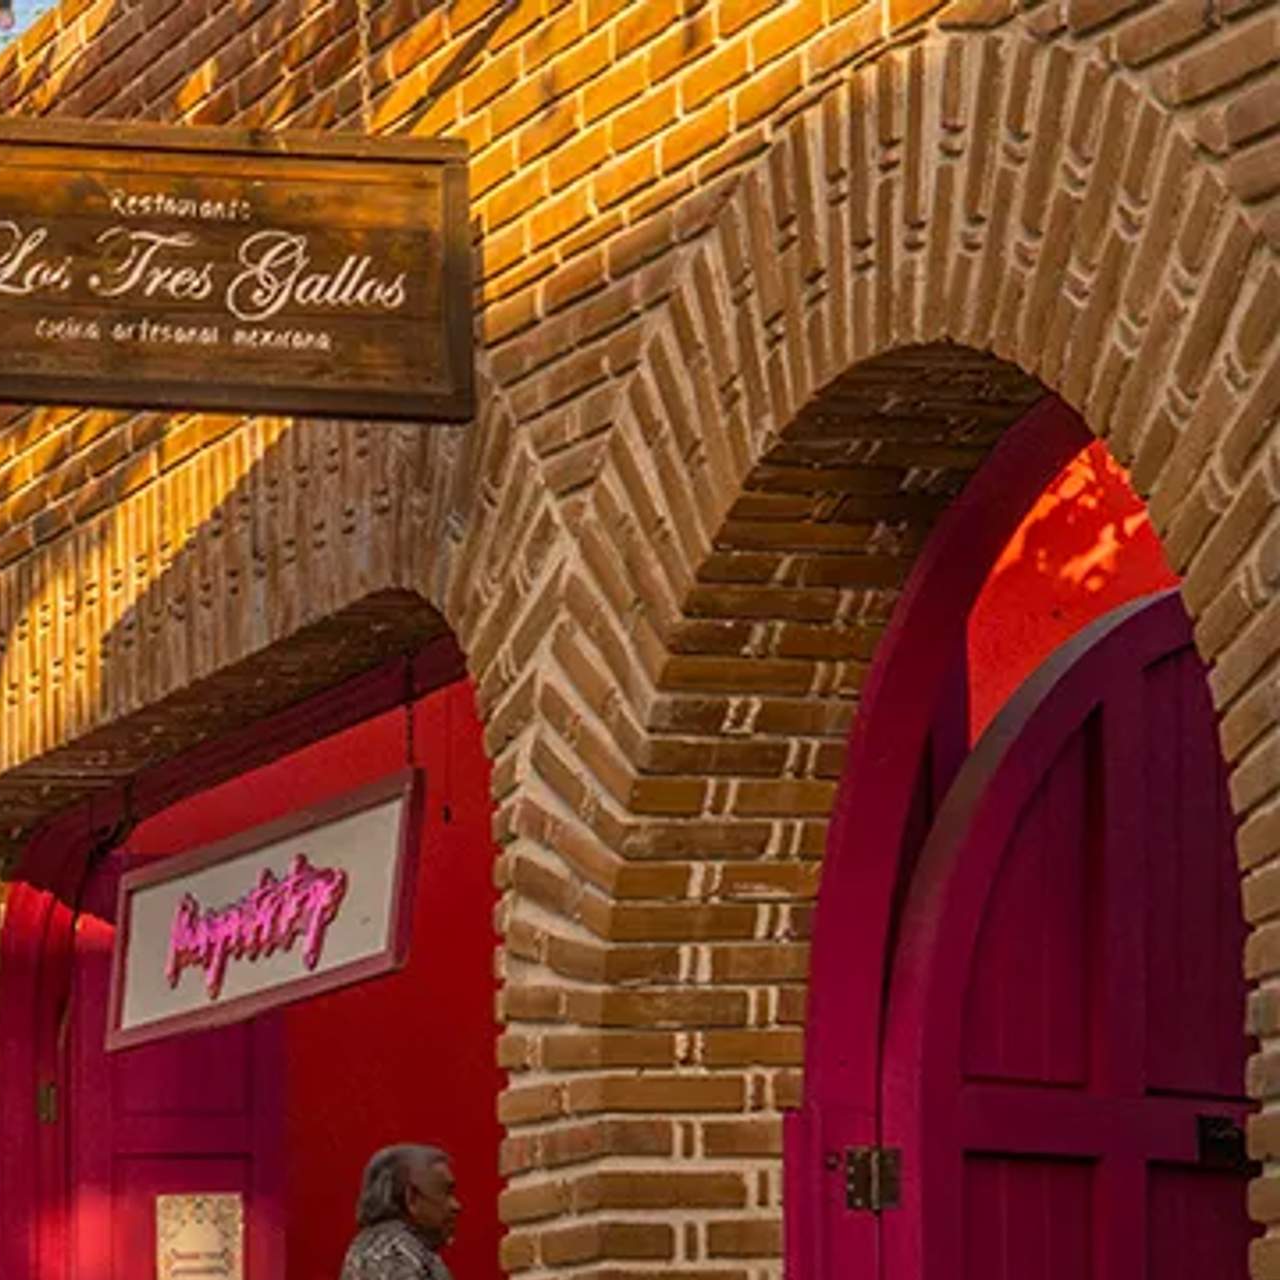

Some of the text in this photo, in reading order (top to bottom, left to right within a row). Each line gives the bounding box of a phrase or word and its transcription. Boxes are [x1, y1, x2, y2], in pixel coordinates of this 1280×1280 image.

[88, 226, 214, 300] Tres
[226, 229, 408, 322] Gallos
[34, 317, 333, 350] cocina artesanal mexicana
